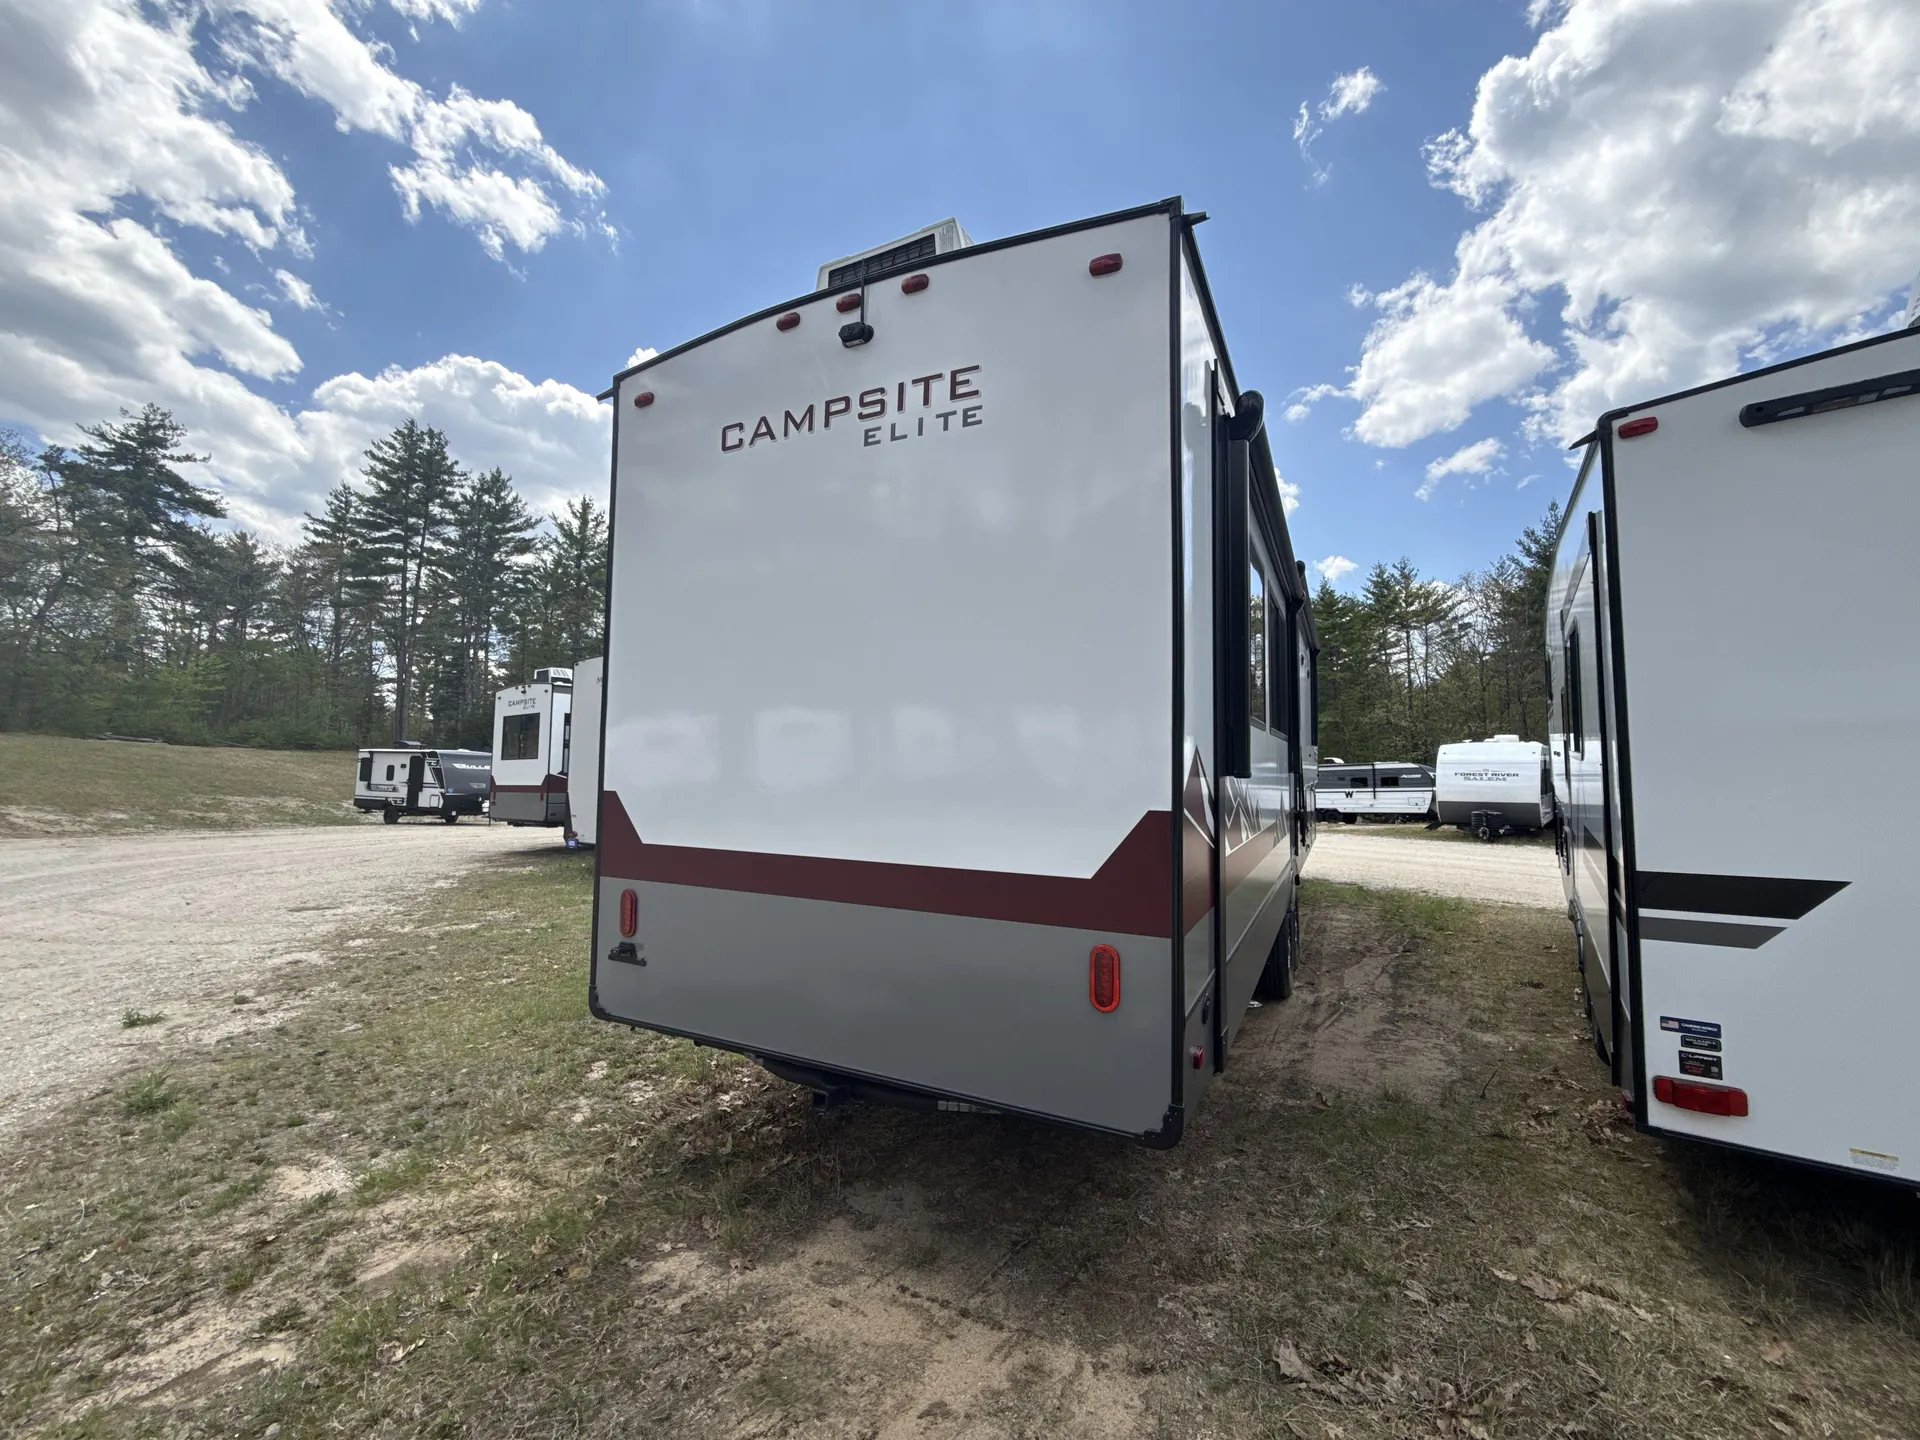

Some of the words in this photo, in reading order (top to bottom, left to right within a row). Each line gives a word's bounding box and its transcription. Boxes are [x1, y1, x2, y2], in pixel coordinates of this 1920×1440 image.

[721, 364, 982, 453] CAMPSITE
[863, 404, 983, 447] ELITE
[508, 698, 537, 707] CAMPSITE
